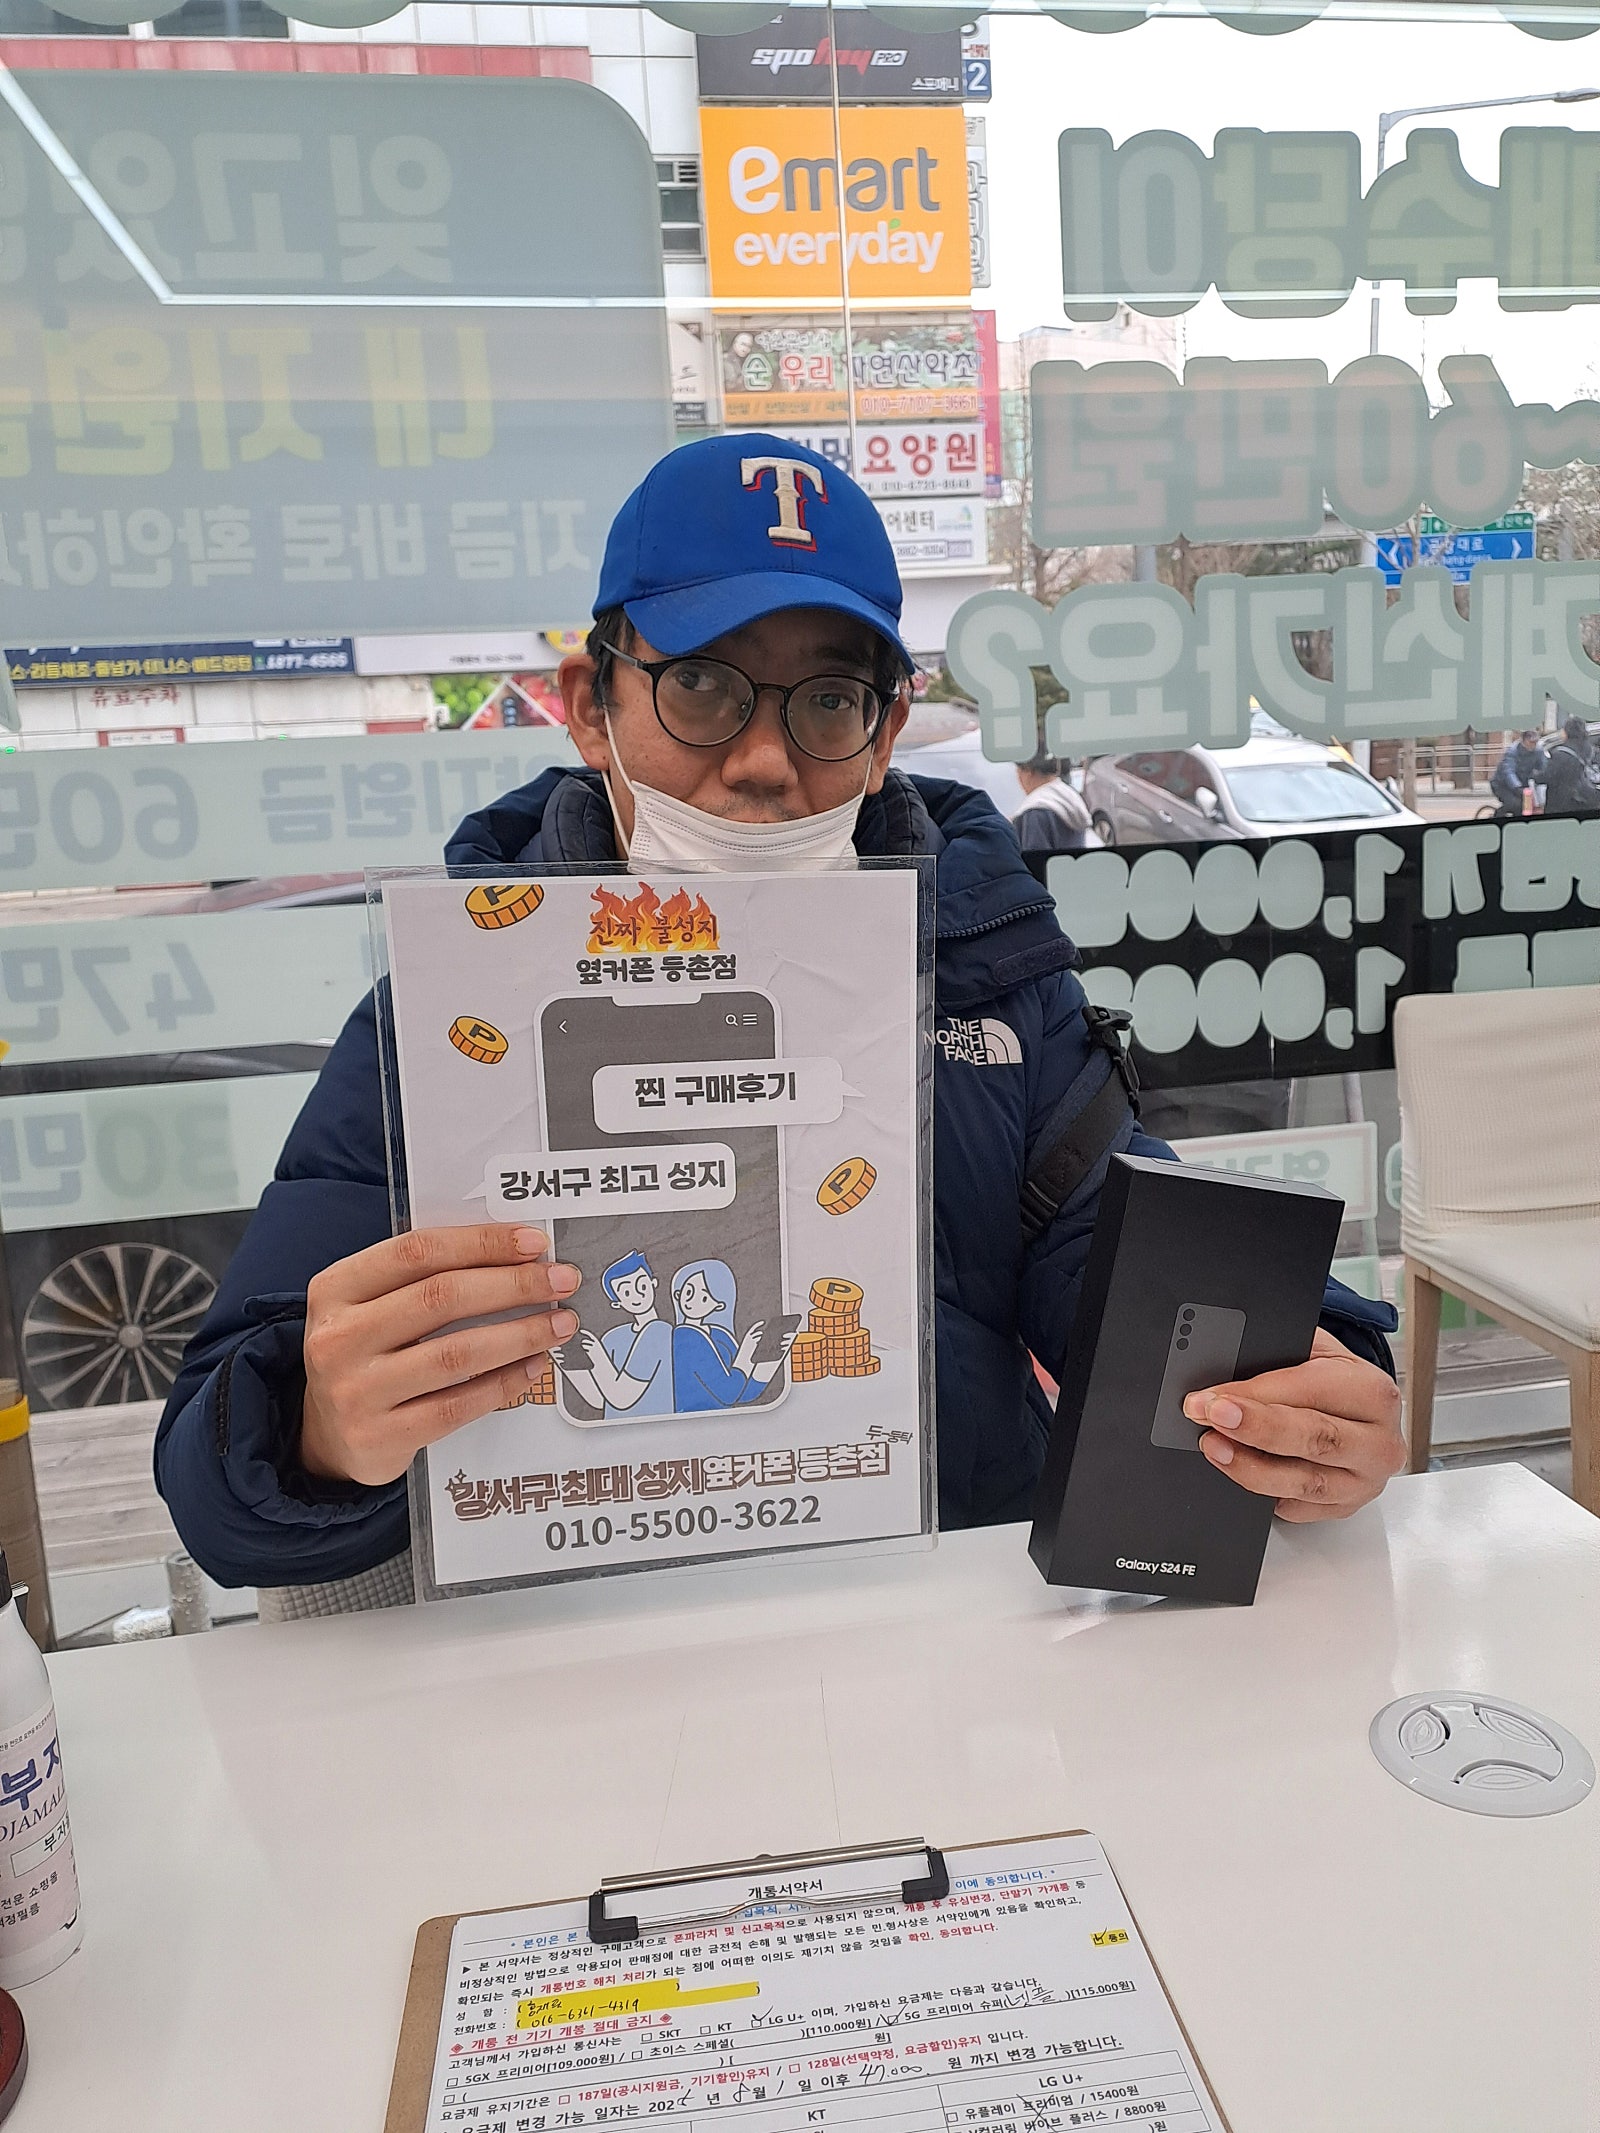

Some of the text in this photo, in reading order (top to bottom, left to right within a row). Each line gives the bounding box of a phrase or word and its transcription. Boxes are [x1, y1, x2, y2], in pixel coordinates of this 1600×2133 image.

[729, 146, 941, 214] emart
[734, 221, 944, 273] everyday
[782, 355, 833, 388] 우리
[863, 434, 977, 476] 요양원
[741, 456, 828, 551] T
[880, 509, 935, 533] 어센터
[590, 915, 641, 946] 진짜
[576, 953, 737, 985] 옆커폰 등촌점
[922, 1030, 984, 1051] NORTH
[947, 1017, 981, 1036] THE
[944, 1046, 988, 1066] FACE
[634, 1071, 797, 1108] 찐 구매후기
[500, 1158, 726, 1201] 강서구 최고 성지
[453, 1442, 891, 1520] 강서구 최대 성지 옆커폰 등촌점
[544, 1495, 822, 1552] 010-5500-3622
[1115, 1557, 1197, 1576] Galaxy S24 FE
[29, 1871, 59, 1899] 쇼핑몰
[748, 1879, 823, 1900] 개통서약서
[955, 1870, 1047, 1889] 이에 동의합니다.
[496, 1955, 542, 1968] 서약서는
[548, 1946, 593, 1961] 정상적인
[599, 1937, 667, 1953] 구매고객으로
[673, 1928, 718, 1943] 폰파라치
[742, 1919, 807, 1934] 신고목적으로
[814, 1911, 858, 1925] 사용되지
[999, 1888, 1032, 1899] 단말기
[1037, 1882, 1069, 1894] 가개통
[523, 1935, 559, 1949] 본인은
[1107, 1930, 1129, 1943] 동의
[460, 1973, 517, 1989] 비정상적인
[525, 1966, 570, 1980] 방법으로
[577, 1958, 622, 1972] 악용되어
[629, 1951, 673, 1966] 판매점에
[680, 1947, 702, 1957] 대한
[708, 1941, 742, 1954] 금전적
[748, 1938, 770, 1949] 손해
[794, 1931, 837, 1943] 발행되는
[844, 1926, 865, 1936] 모든
[936, 1908, 990, 1923] 서약인에게
[996, 1903, 1028, 1915] 있음을
[458, 1993, 504, 2005] 확인되는
[511, 1987, 534, 1998] 즉시
[539, 1980, 587, 1995] 개통번호
[622, 1969, 656, 1983] 처리가
[662, 1966, 685, 1978] 되는
[721, 1956, 755, 1967] 어떠한
[762, 1951, 795, 1963] 이의도
[841, 1942, 862, 1952] 않을
[869, 1936, 902, 1948] 것임을
[939, 1923, 998, 1938] 동의합니다.
[449, 2052, 511, 2069] 고객님께서
[518, 2044, 565, 2059] 가입하신
[574, 2037, 622, 2051] 통신사는
[659, 2029, 681, 2040] SKT
[717, 2023, 732, 2031] KT
[768, 2016, 783, 2024] LG
[844, 1998, 890, 2013] 가입하신
[898, 1991, 943, 2005] 요금제는
[950, 1984, 985, 1997] 다음과
[991, 1978, 1041, 1992] 같습니다.
[454, 2023, 496, 2035] 전화번호
[472, 2013, 652, 2049] 개통 전 기기 개봉 절대 금지
[465, 2073, 490, 2083] 5GX
[650, 2045, 685, 2057] 초이스
[905, 2011, 920, 2020] 5G
[927, 2002, 973, 2016] 프리미어
[948, 2035, 1122, 2069] 원 까지 변경 가능합니다.
[440, 2106, 479, 2120] 요금제
[486, 2097, 550, 2115] 유지기간은
[988, 2030, 1028, 2043] 입니다.
[1039, 2074, 1083, 2088] LG U+
[516, 2116, 545, 2131] 변경
[555, 2112, 585, 2125] 가능
[595, 2104, 639, 2120] 일자는
[707, 2093, 720, 2105] 년
[798, 2079, 812, 2092] 일
[821, 2074, 850, 2088] 이후
[808, 2109, 826, 2121] KT
[965, 2103, 1016, 2120] 유플레이
[1090, 2085, 1139, 2101] 15400원
[1069, 2111, 1108, 2125] 플러스
[1124, 2101, 1167, 2116] 8800원
